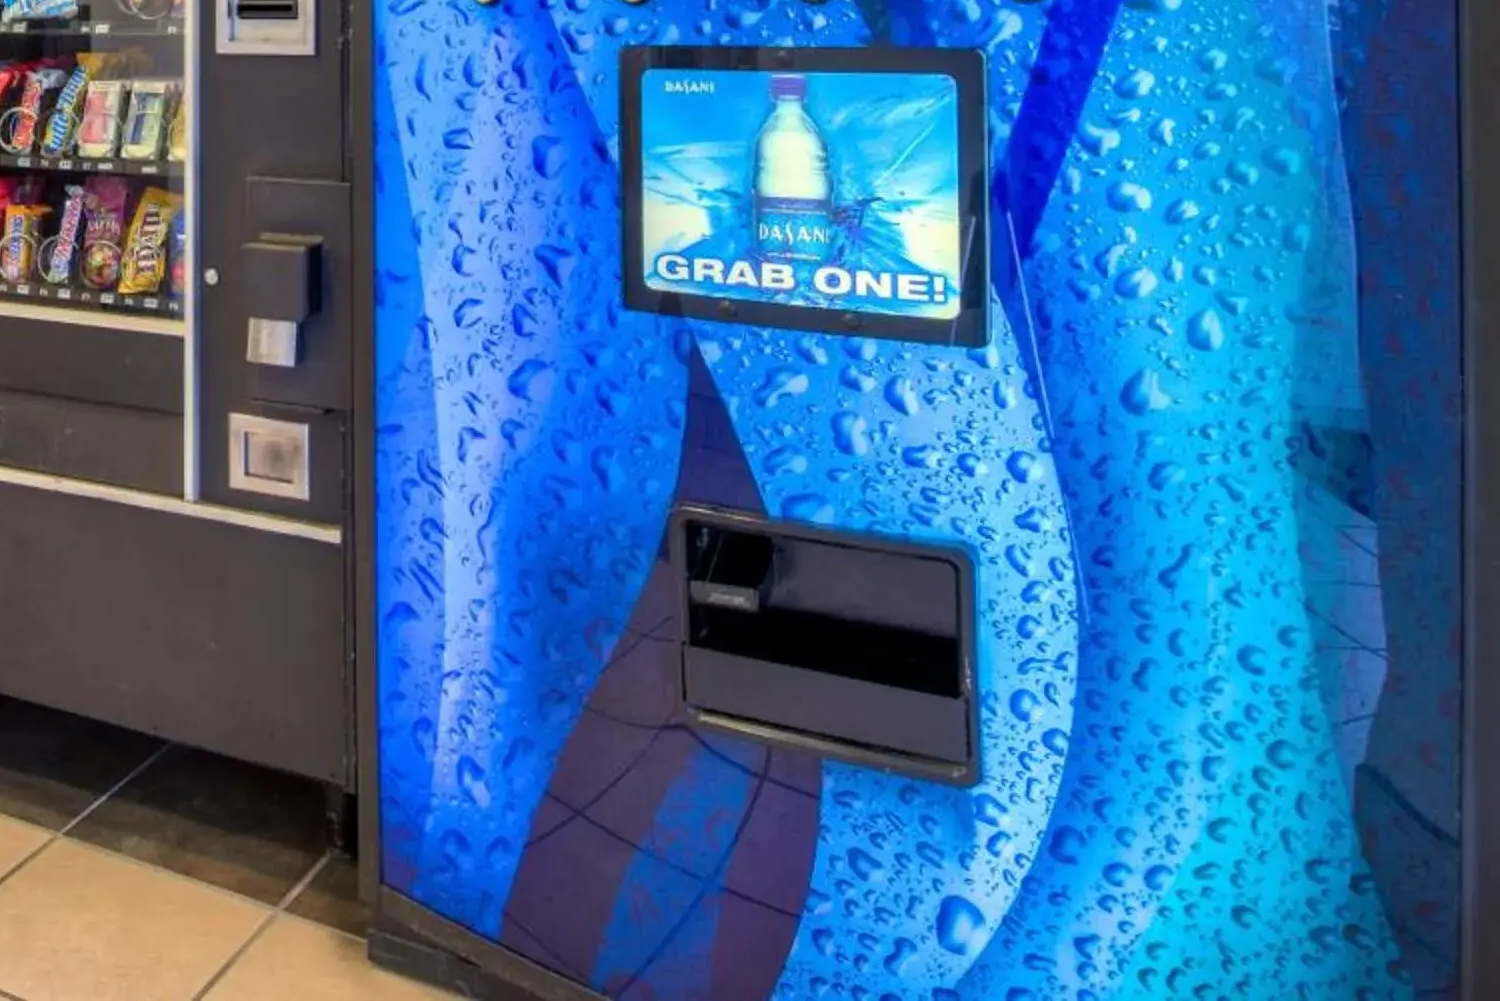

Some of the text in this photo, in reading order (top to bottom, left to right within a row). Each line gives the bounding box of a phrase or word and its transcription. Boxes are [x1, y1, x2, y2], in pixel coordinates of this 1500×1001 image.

[664, 80, 715, 96] DASANI
[758, 221, 832, 246] DASANI
[656, 253, 949, 303] GRAB ONE!
